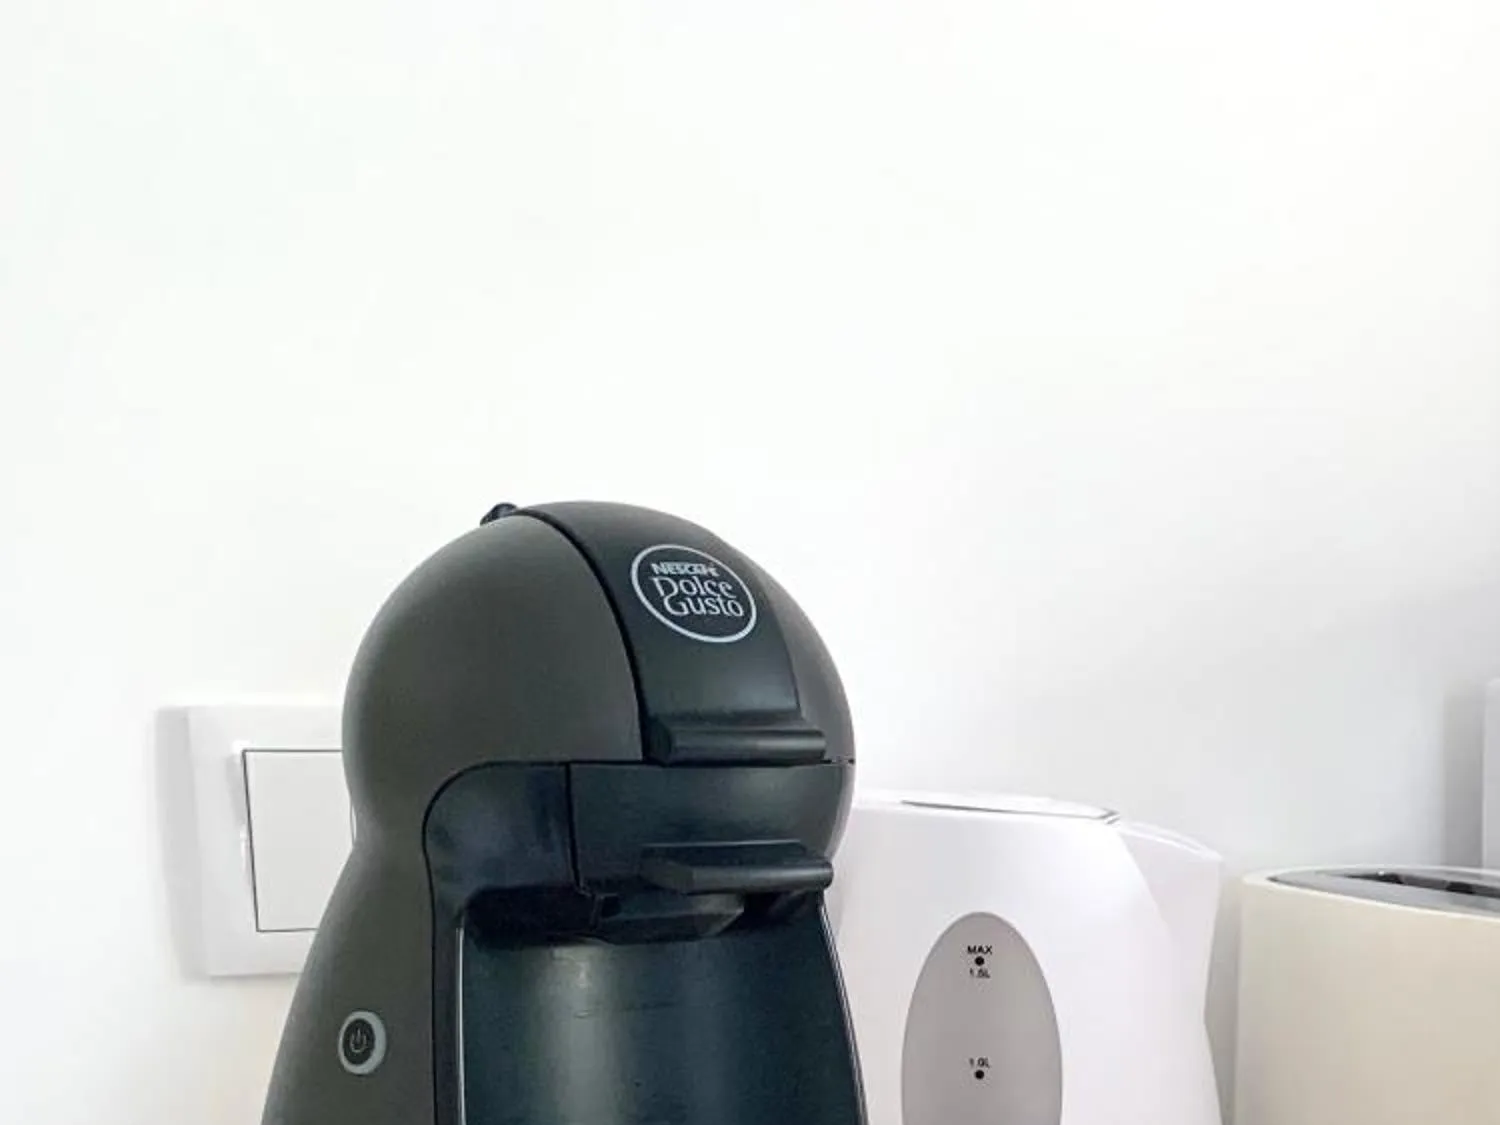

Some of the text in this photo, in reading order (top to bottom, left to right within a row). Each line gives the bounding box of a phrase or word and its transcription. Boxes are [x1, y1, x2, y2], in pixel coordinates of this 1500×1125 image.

[651, 576, 737, 598] Dolce
[663, 596, 744, 616] Gusto
[967, 945, 993, 954] MAX
